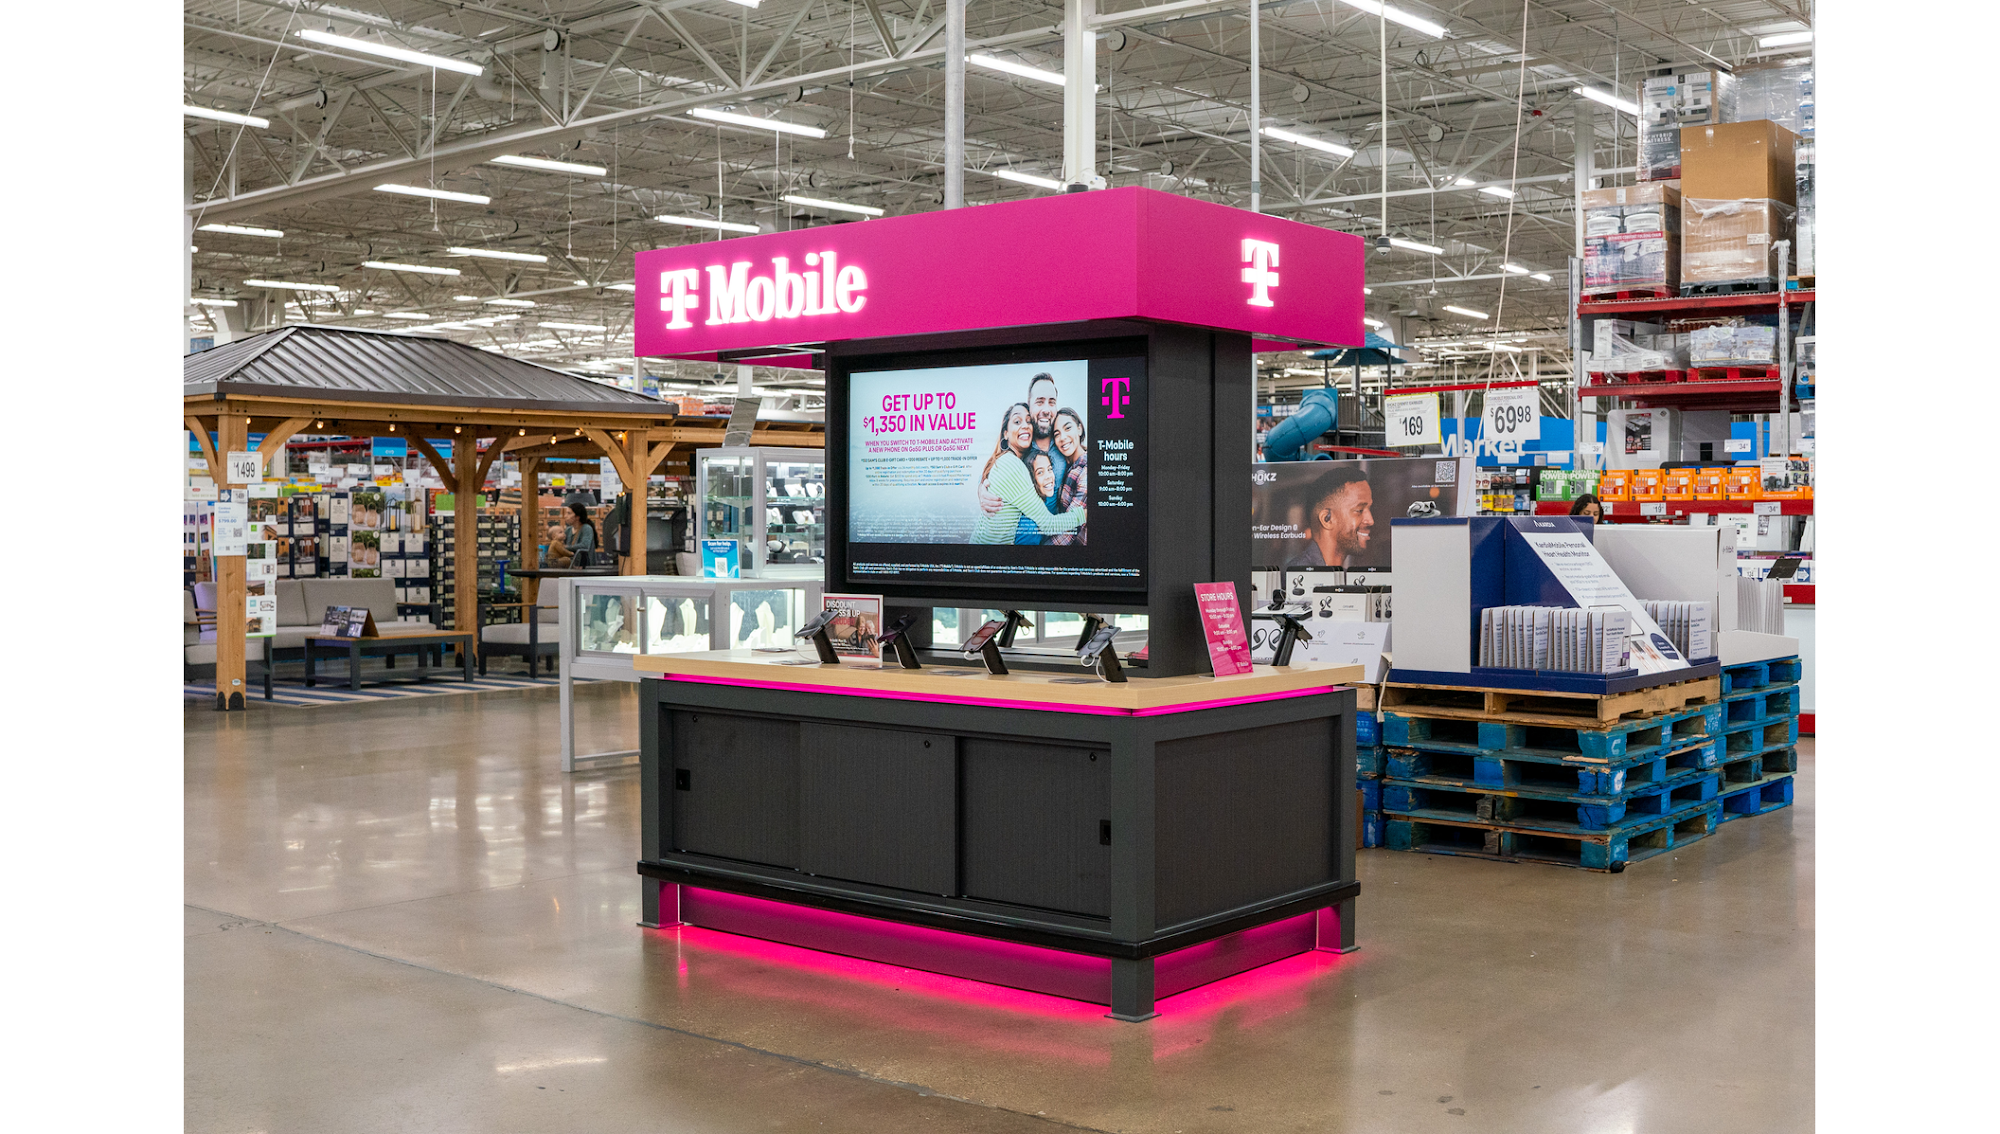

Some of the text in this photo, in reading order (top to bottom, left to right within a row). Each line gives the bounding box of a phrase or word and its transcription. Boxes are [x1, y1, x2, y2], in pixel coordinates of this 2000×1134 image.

[705, 250, 868, 326] Mobile
[882, 392, 956, 412] GET UP TO
[863, 412, 976, 436] $1,350 IN VALUE
[1097, 439, 1134, 450] T-Mobile
[1441, 434, 1526, 457] Market
[1104, 451, 1128, 462] hours
[1252, 472, 1277, 483] HOKZ
[1271, 524, 1292, 532] Design
[1200, 592, 1234, 602] STORE HOURS
[826, 600, 856, 609] DISCOUNT
[852, 610, 860, 618] UP
